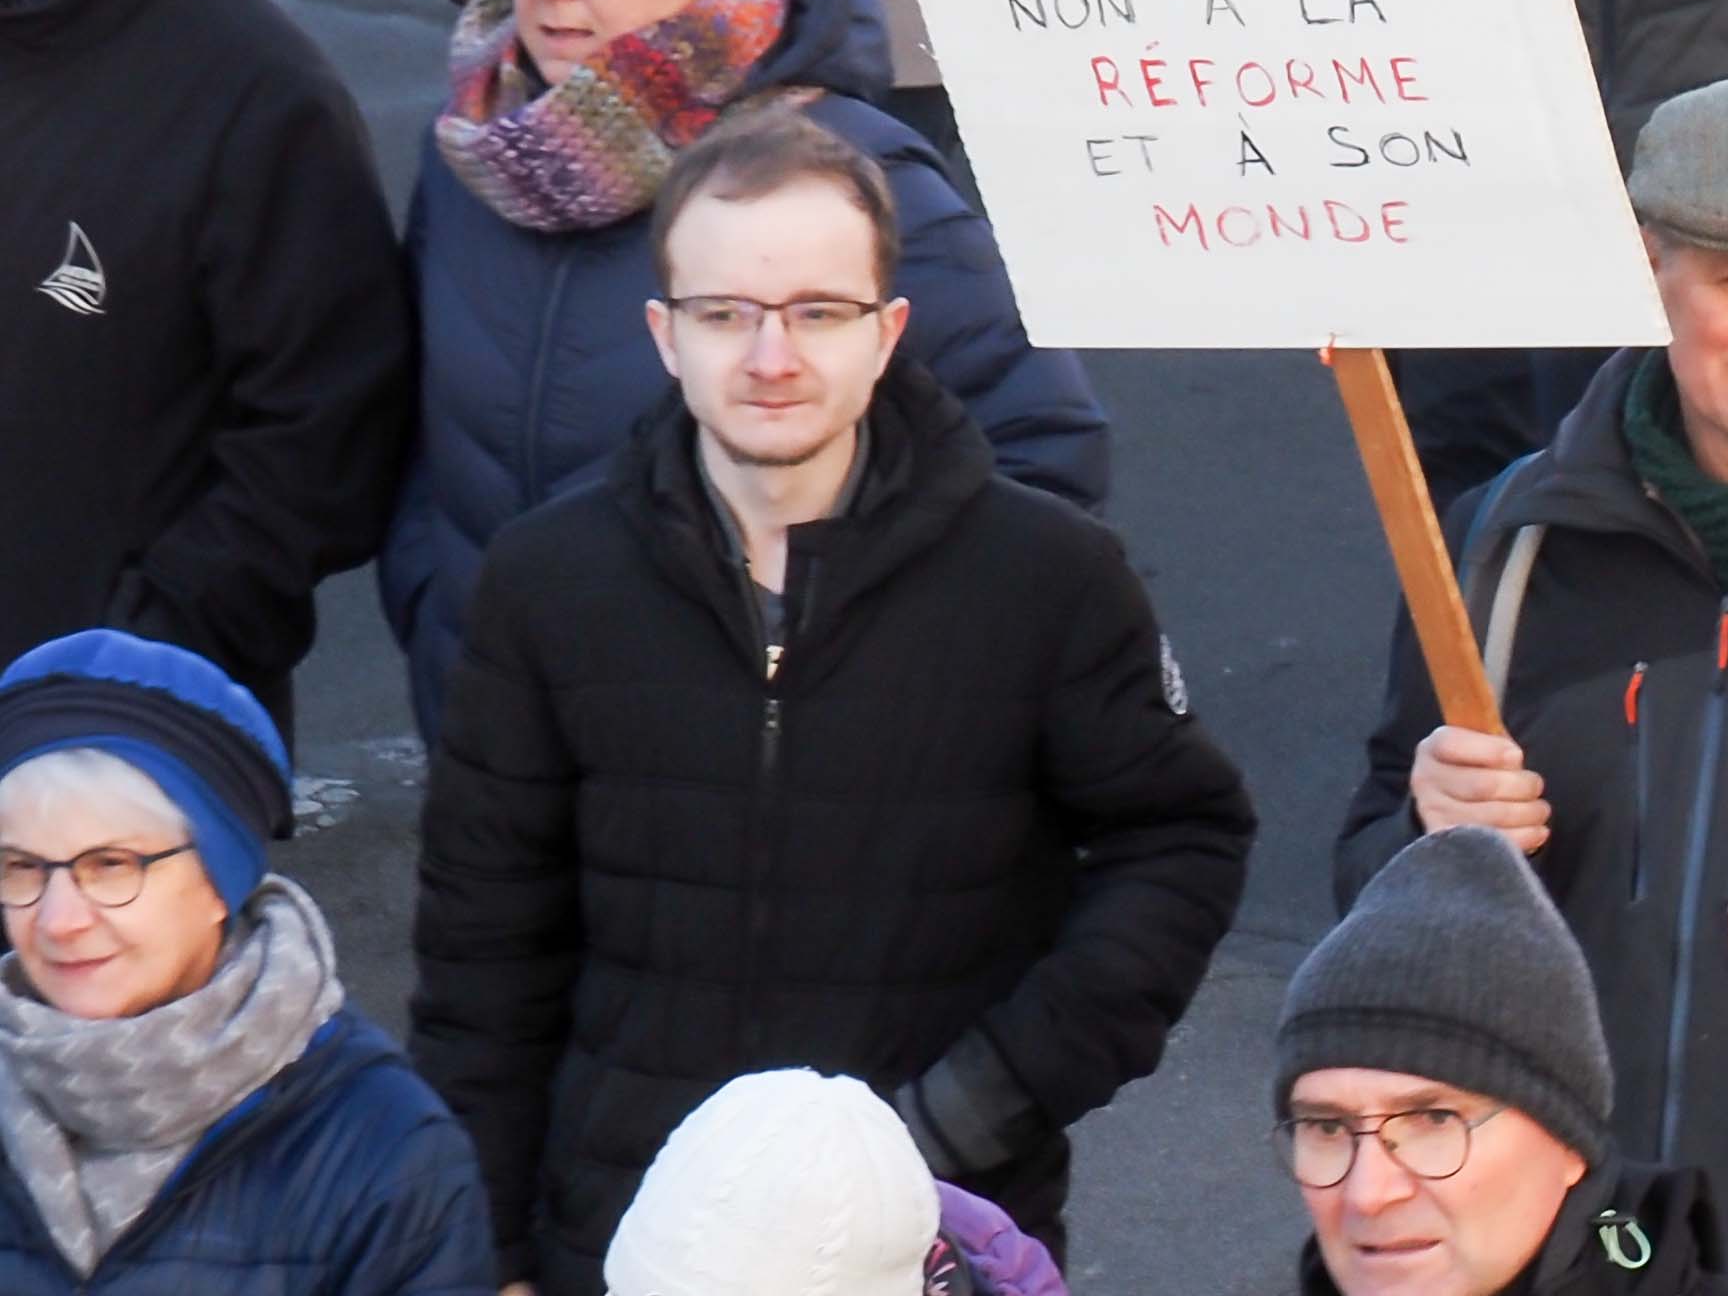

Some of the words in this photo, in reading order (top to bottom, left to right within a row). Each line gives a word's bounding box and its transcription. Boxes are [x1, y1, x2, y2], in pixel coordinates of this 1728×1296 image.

[1091, 40, 1429, 108] RÉFORME
[1086, 134, 1160, 177] ET
[1236, 110, 1277, 178] À
[1327, 125, 1472, 168] SON
[1153, 200, 1410, 252] MONDE
